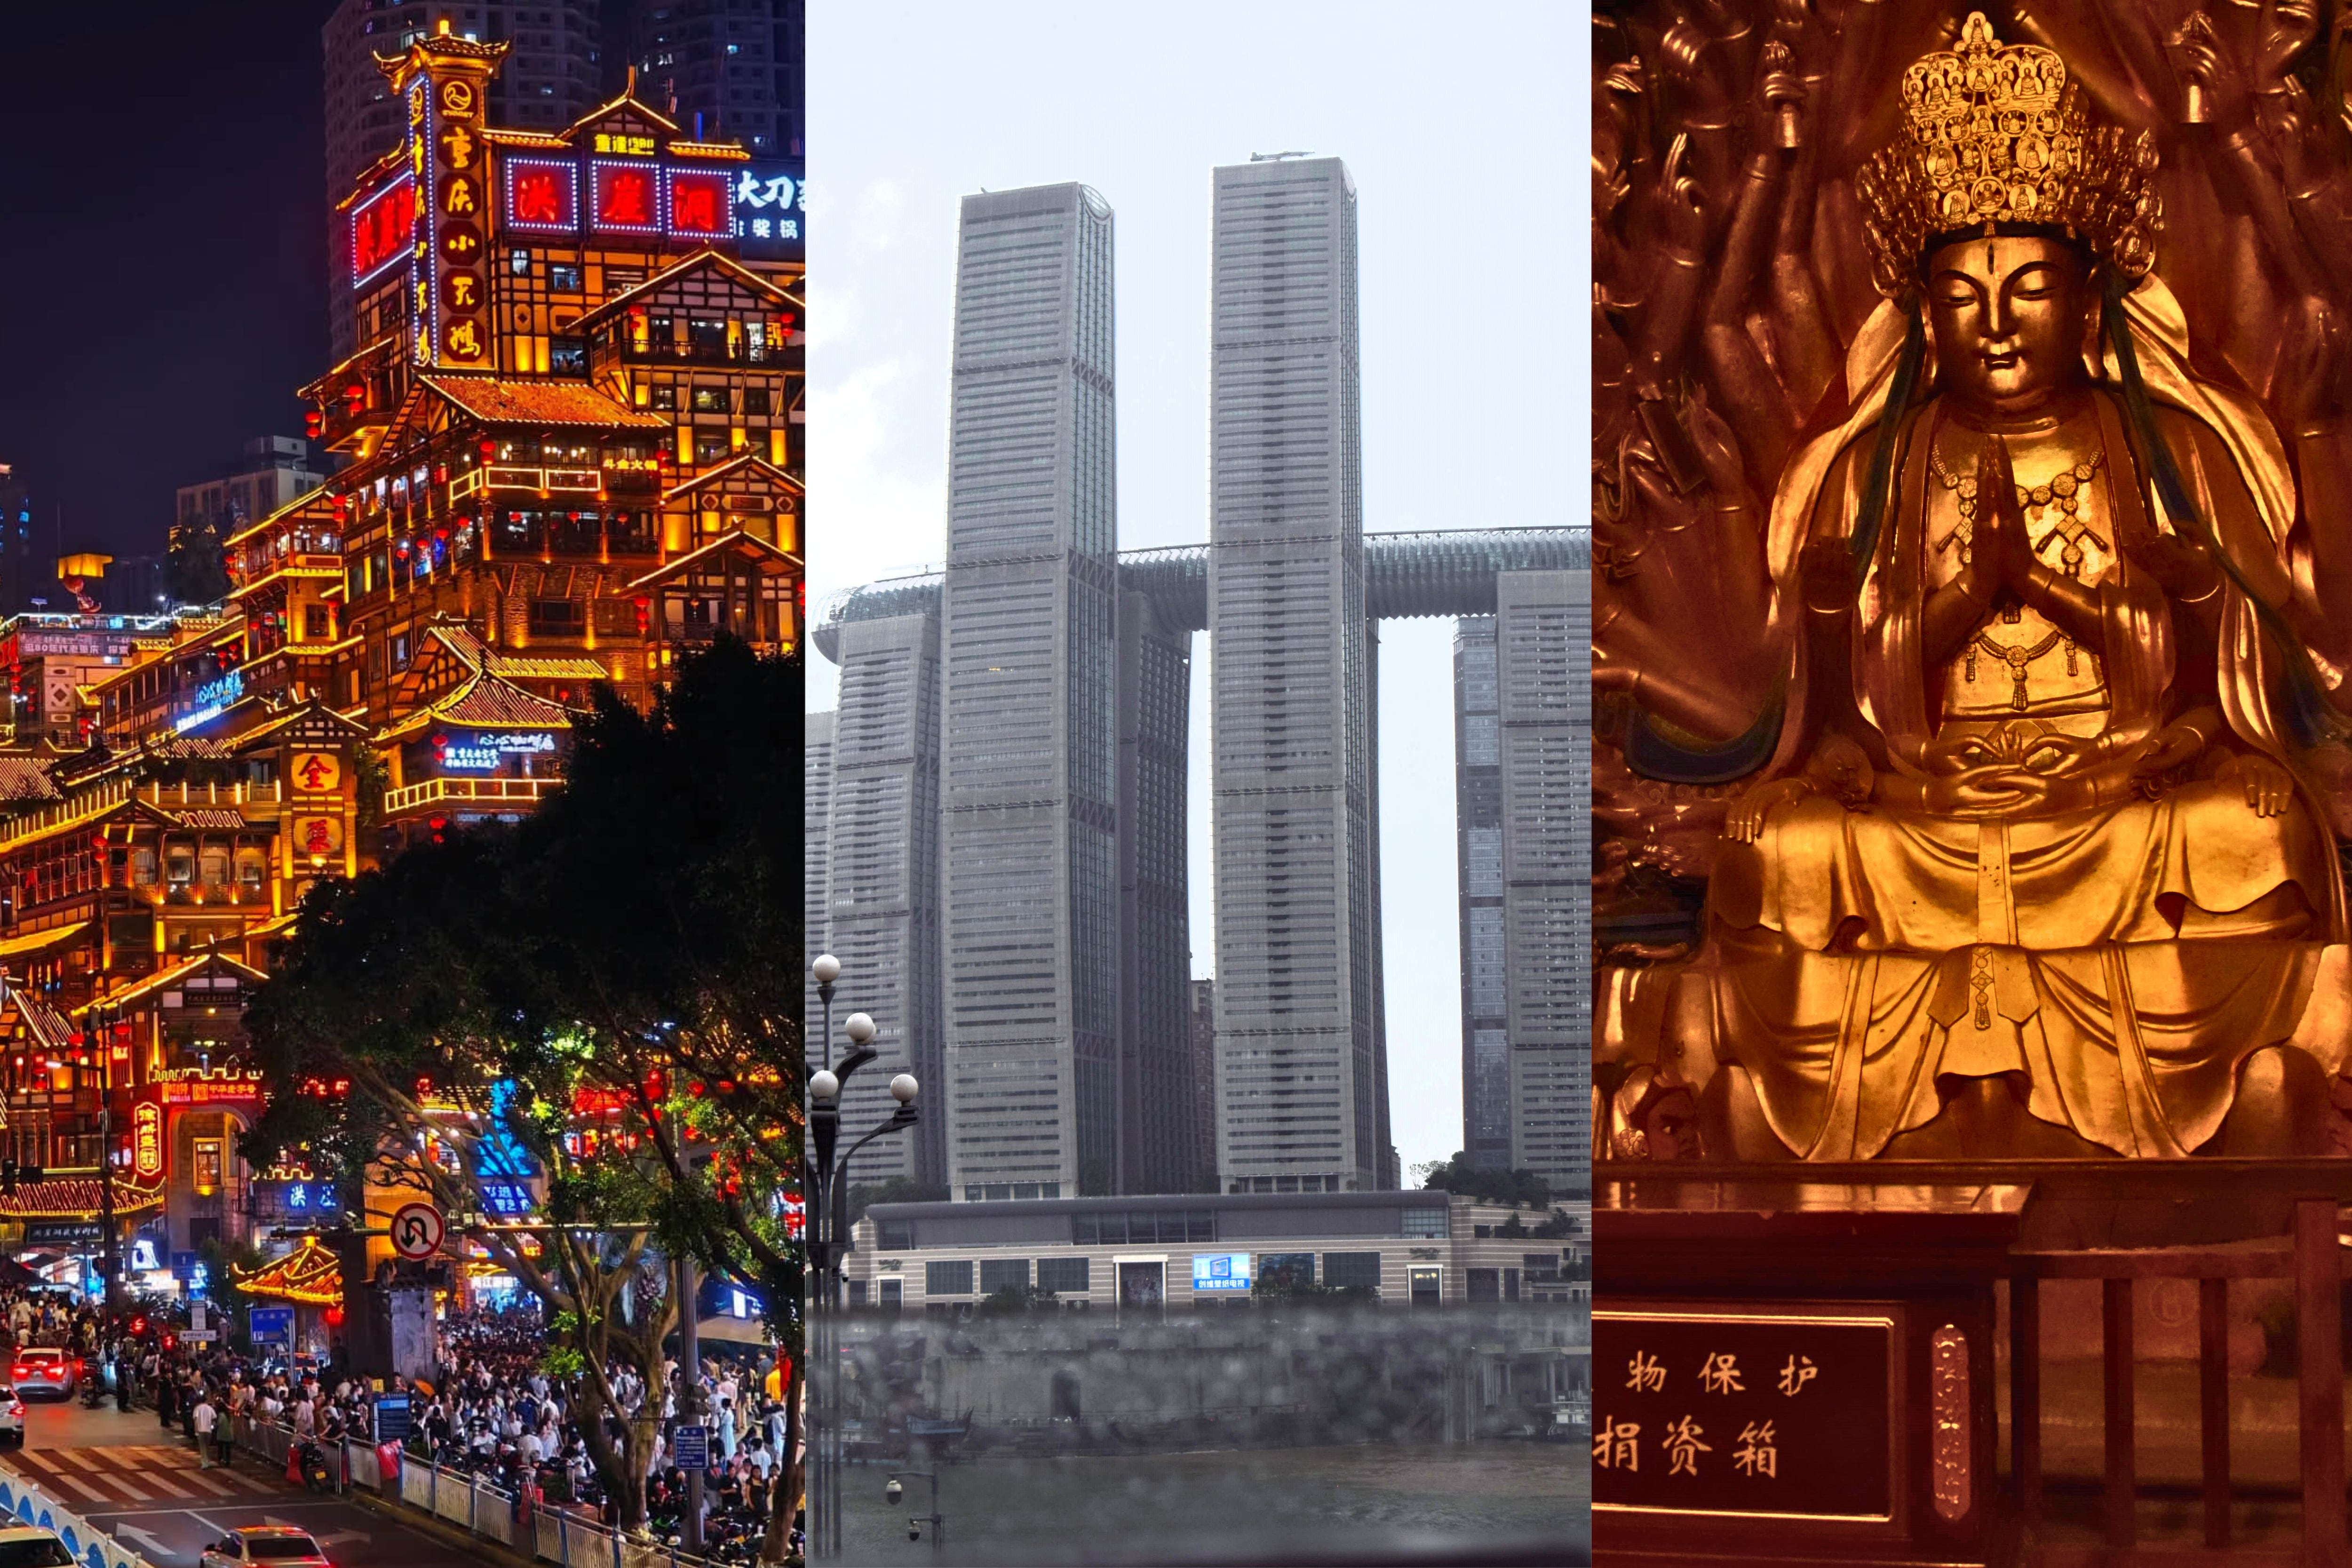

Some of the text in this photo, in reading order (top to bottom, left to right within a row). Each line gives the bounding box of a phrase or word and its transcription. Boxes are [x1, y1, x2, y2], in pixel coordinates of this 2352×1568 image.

[520, 174, 713, 230] 洪崖洞
[1199, 1279, 1245, 1288] 创维壁纸电视
[1626, 1350, 1818, 1397] 物保护
[1592, 1414, 1777, 1479] 捐资箱
